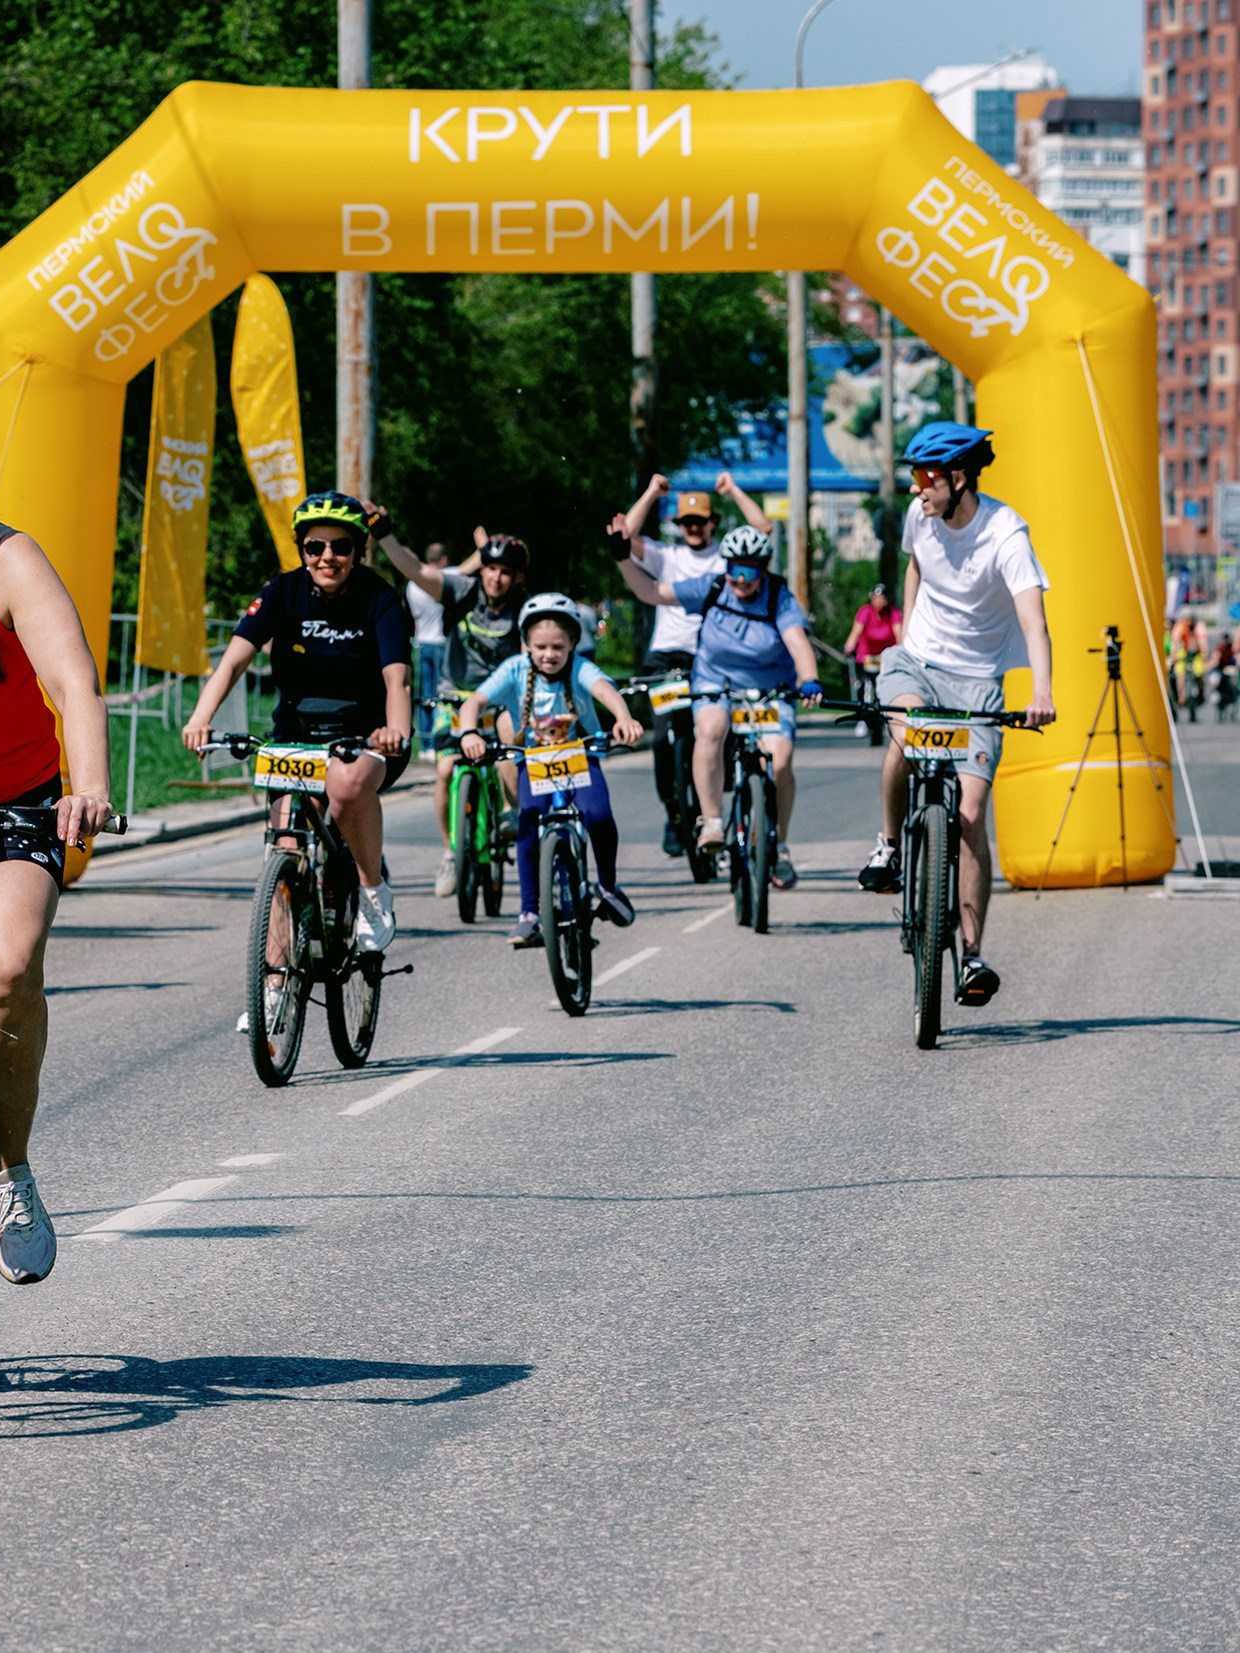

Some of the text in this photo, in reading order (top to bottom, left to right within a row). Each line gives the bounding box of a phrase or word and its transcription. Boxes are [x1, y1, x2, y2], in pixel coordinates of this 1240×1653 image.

[407, 103, 693, 163] КРУТИ
[25, 169, 156, 292] ПЕРМСКИЙ
[341, 193, 761, 256] В ПЕРМИ!
[943, 155, 1077, 269] ПЕРМСКИЙ
[268, 758, 316, 778] 1030
[544, 760, 571, 778] 151
[920, 731, 955, 747] 707
